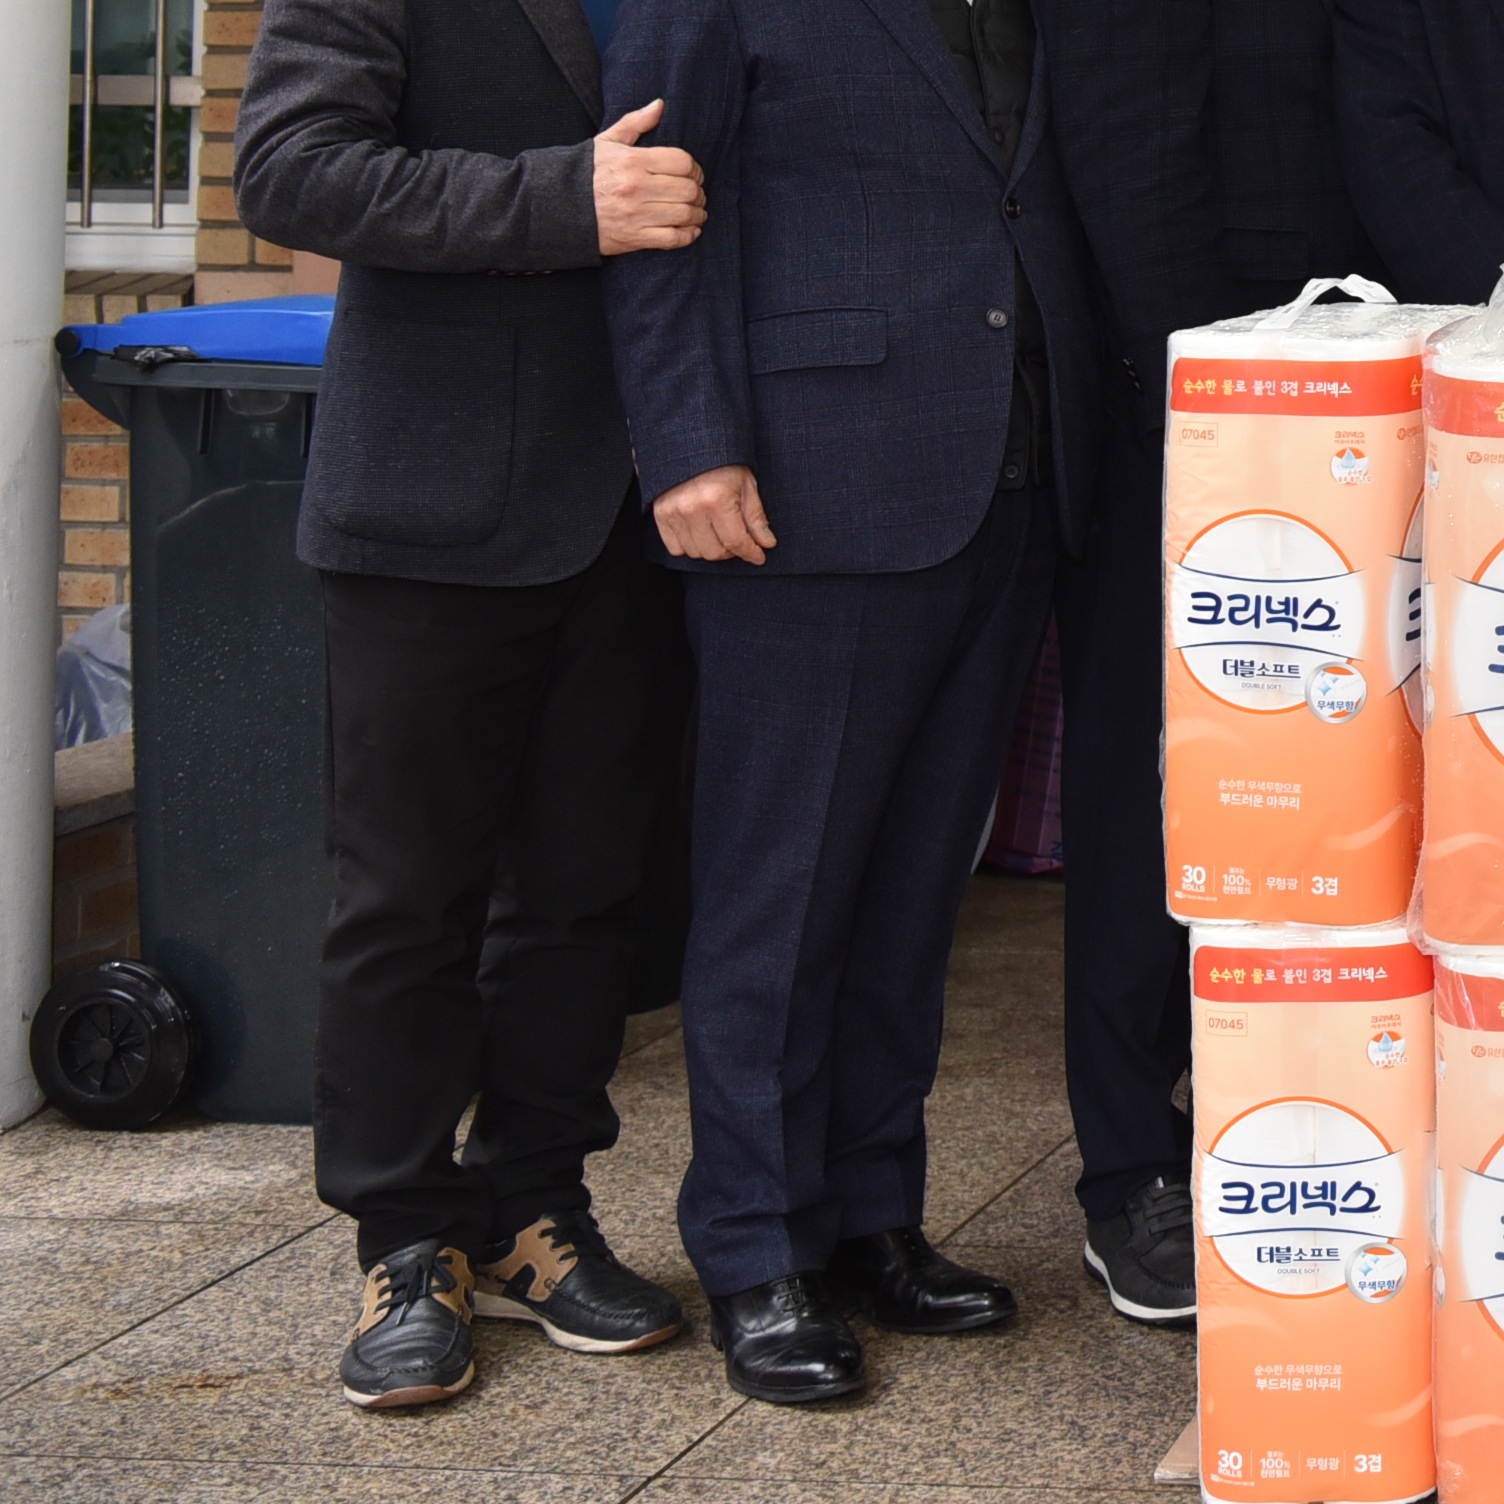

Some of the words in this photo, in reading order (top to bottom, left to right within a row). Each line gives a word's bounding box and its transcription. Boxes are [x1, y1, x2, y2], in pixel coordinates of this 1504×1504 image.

[1182, 427, 1214, 442] 07045
[1187, 592, 1342, 633] 크리넥스
[1221, 658, 1302, 679] 더블소프트
[1182, 865, 1206, 884] 30
[1222, 875, 1251, 886] 100%
[1311, 876, 1338, 895] 3겹
[1207, 1017, 1244, 1031] 07045
[1218, 1180, 1382, 1216] 크리넥스
[1257, 1245, 1341, 1264] 더블소프트
